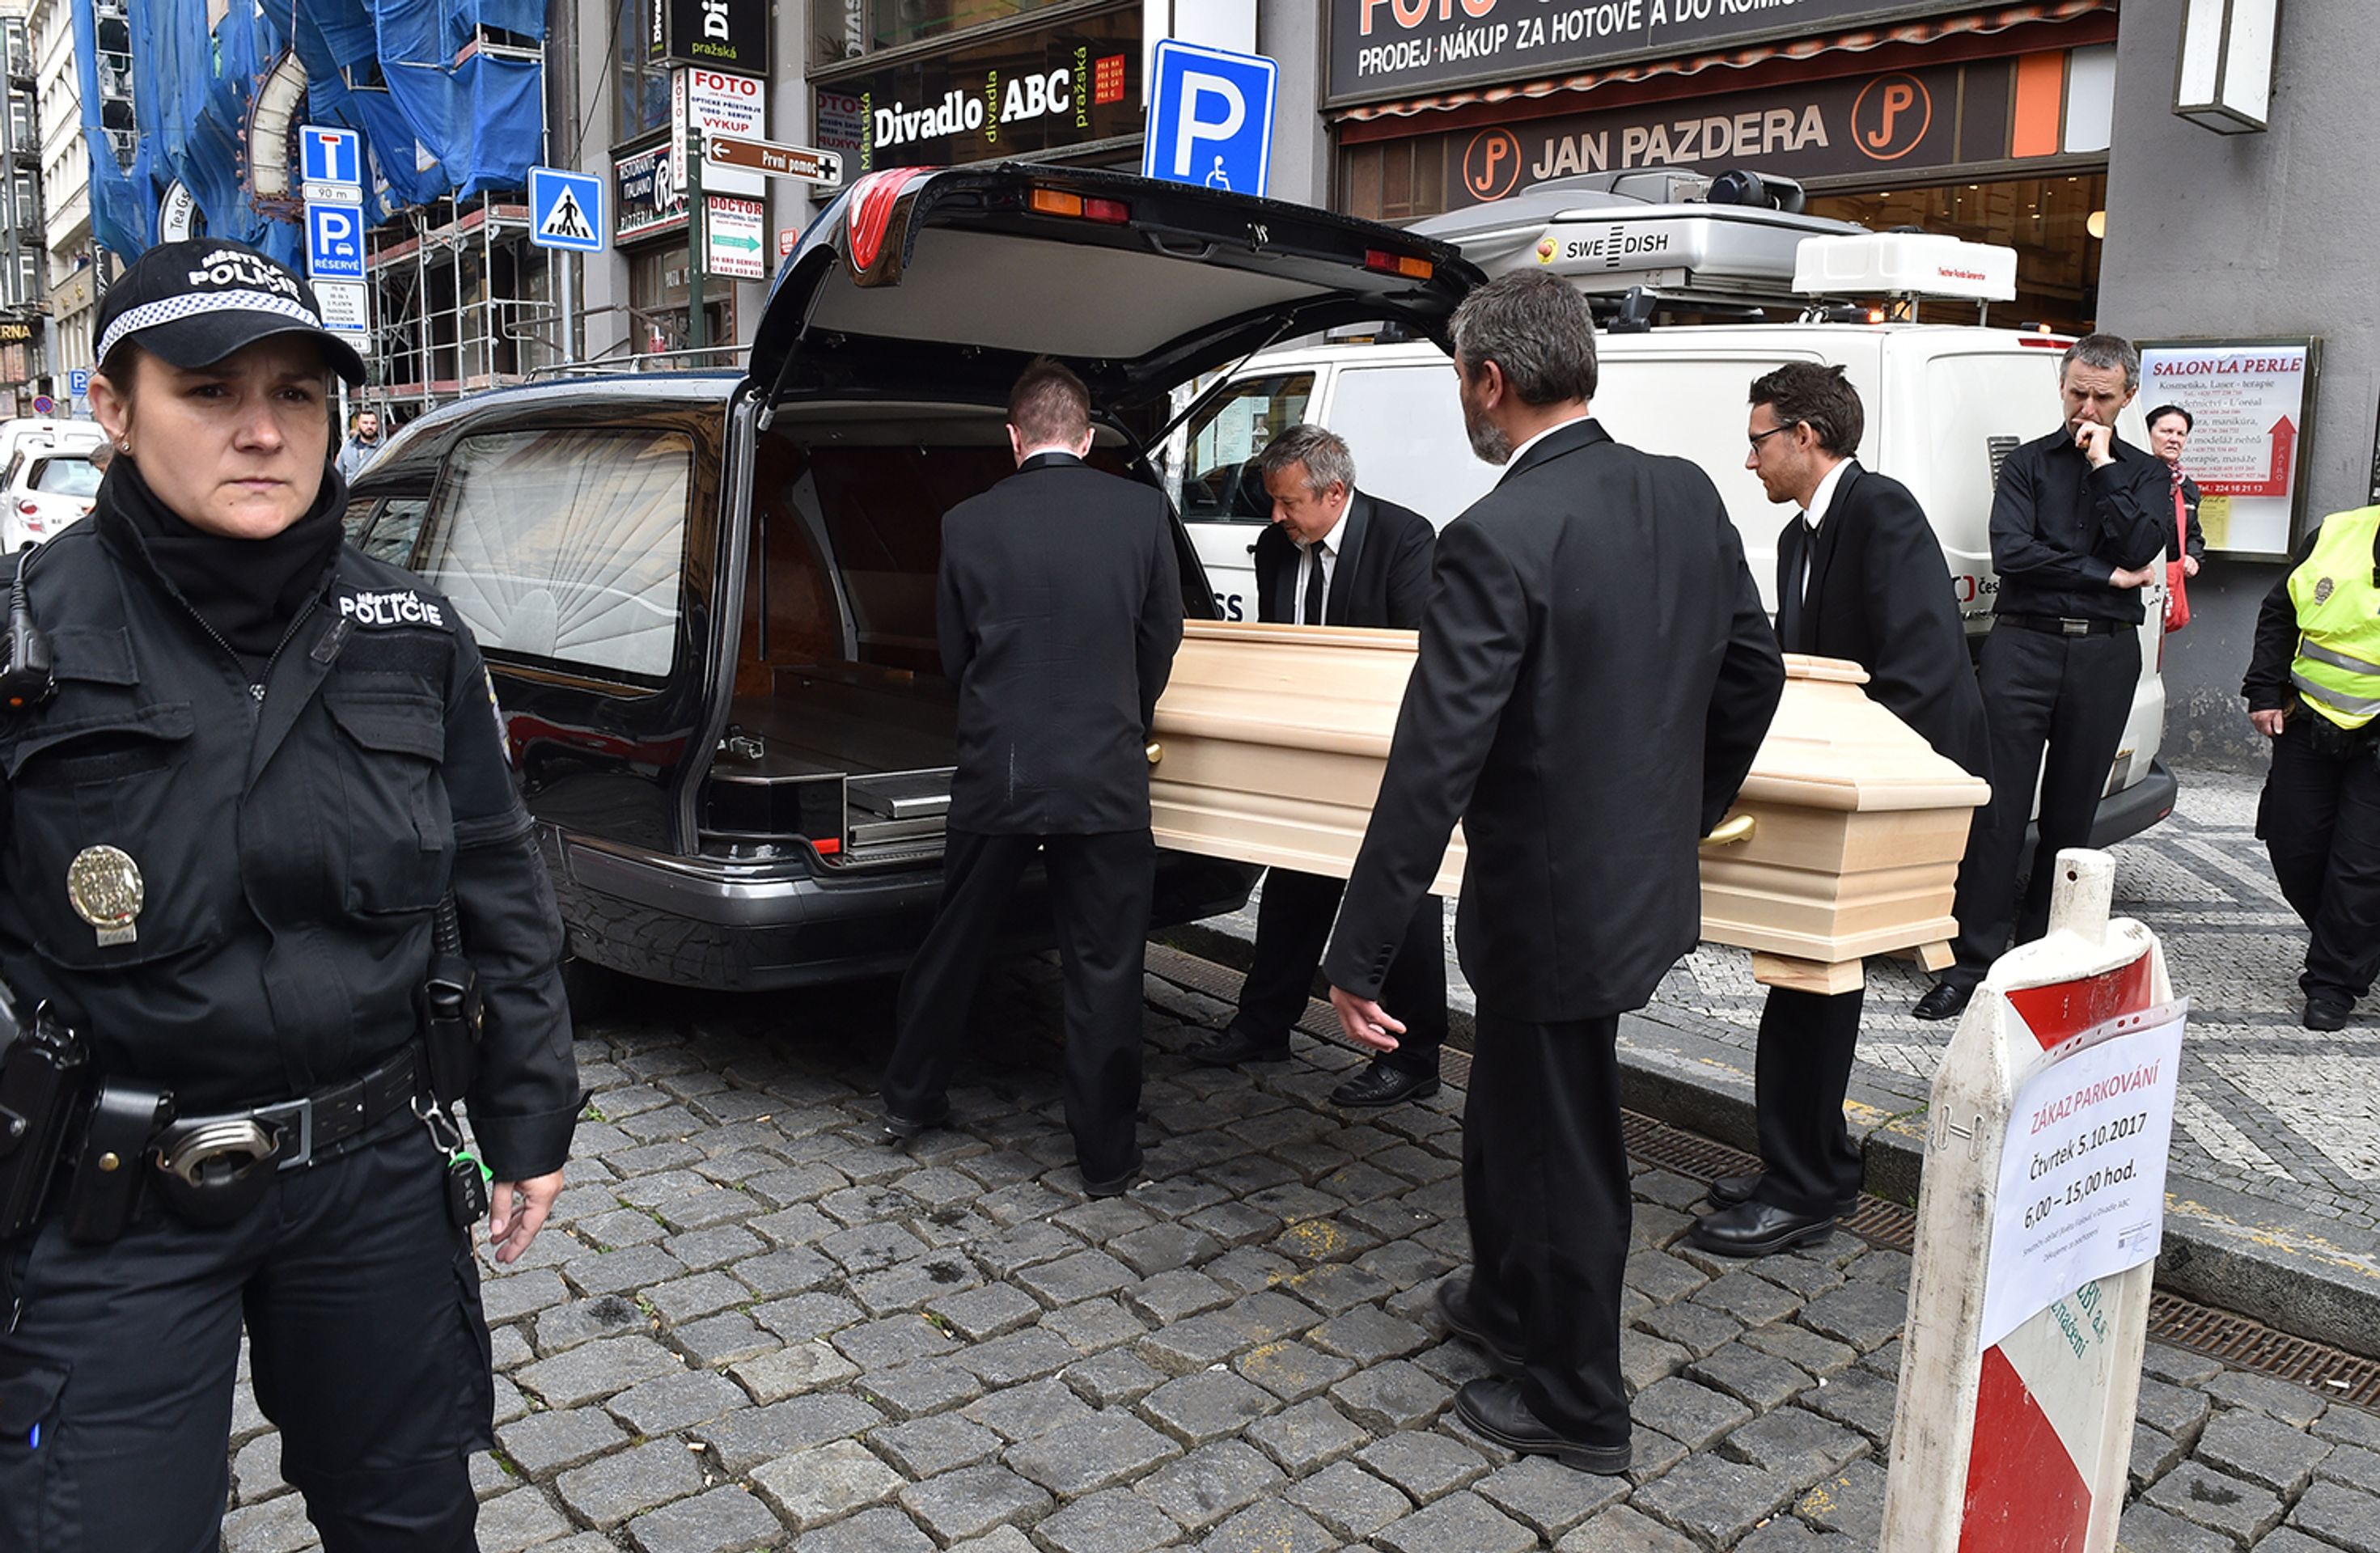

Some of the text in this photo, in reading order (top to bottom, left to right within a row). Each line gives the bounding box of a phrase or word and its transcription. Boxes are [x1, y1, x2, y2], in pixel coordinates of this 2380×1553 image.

[692, 42, 738, 60] pražská
[1358, 37, 1432, 77] PRODEJ
[1440, 23, 1509, 63] NÁKUP
[1515, 18, 1544, 50] ZA
[1650, 0, 1667, 27] A
[695, 70, 757, 97] FOTO
[1074, 46, 1088, 128] pražská
[874, 68, 1069, 149] Divadlo ABC
[985, 70, 998, 143] divadla
[861, 92, 870, 171] Městská
[1174, 70, 1247, 177] P
[1532, 104, 1830, 180] JAN PAZDERA
[763, 150, 816, 175] První pomoc
[318, 187, 347, 199] 90 m
[710, 196, 763, 215] DOCTOR
[170, 209, 185, 231] Tea
[319, 212, 351, 255] P
[620, 209, 654, 231] PIZZERIA
[314, 258, 360, 272] RÉSERVÉ
[188, 263, 302, 303] POLICIE
[0, 324, 32, 339] RNA
[2153, 357, 2303, 376] SALON LA PERLE
[2158, 380, 2208, 390] Kosmetika,
[2209, 379, 2234, 389] Laser
[2242, 379, 2275, 391] terapie
[2181, 455, 2221, 465] oterapie,
[1978, 576, 2000, 595] Čes
[339, 595, 444, 627] POLICIE
[2030, 1058, 2161, 1136] ZÁKAZ PARKOVÁNÍ
[2029, 1112, 2148, 1181] Čtvrtek 5.10.2017
[2023, 1195, 2052, 1231] 6,00
[2064, 1171, 2102, 1207] 15,00
[2103, 1158, 2138, 1187] hod.
